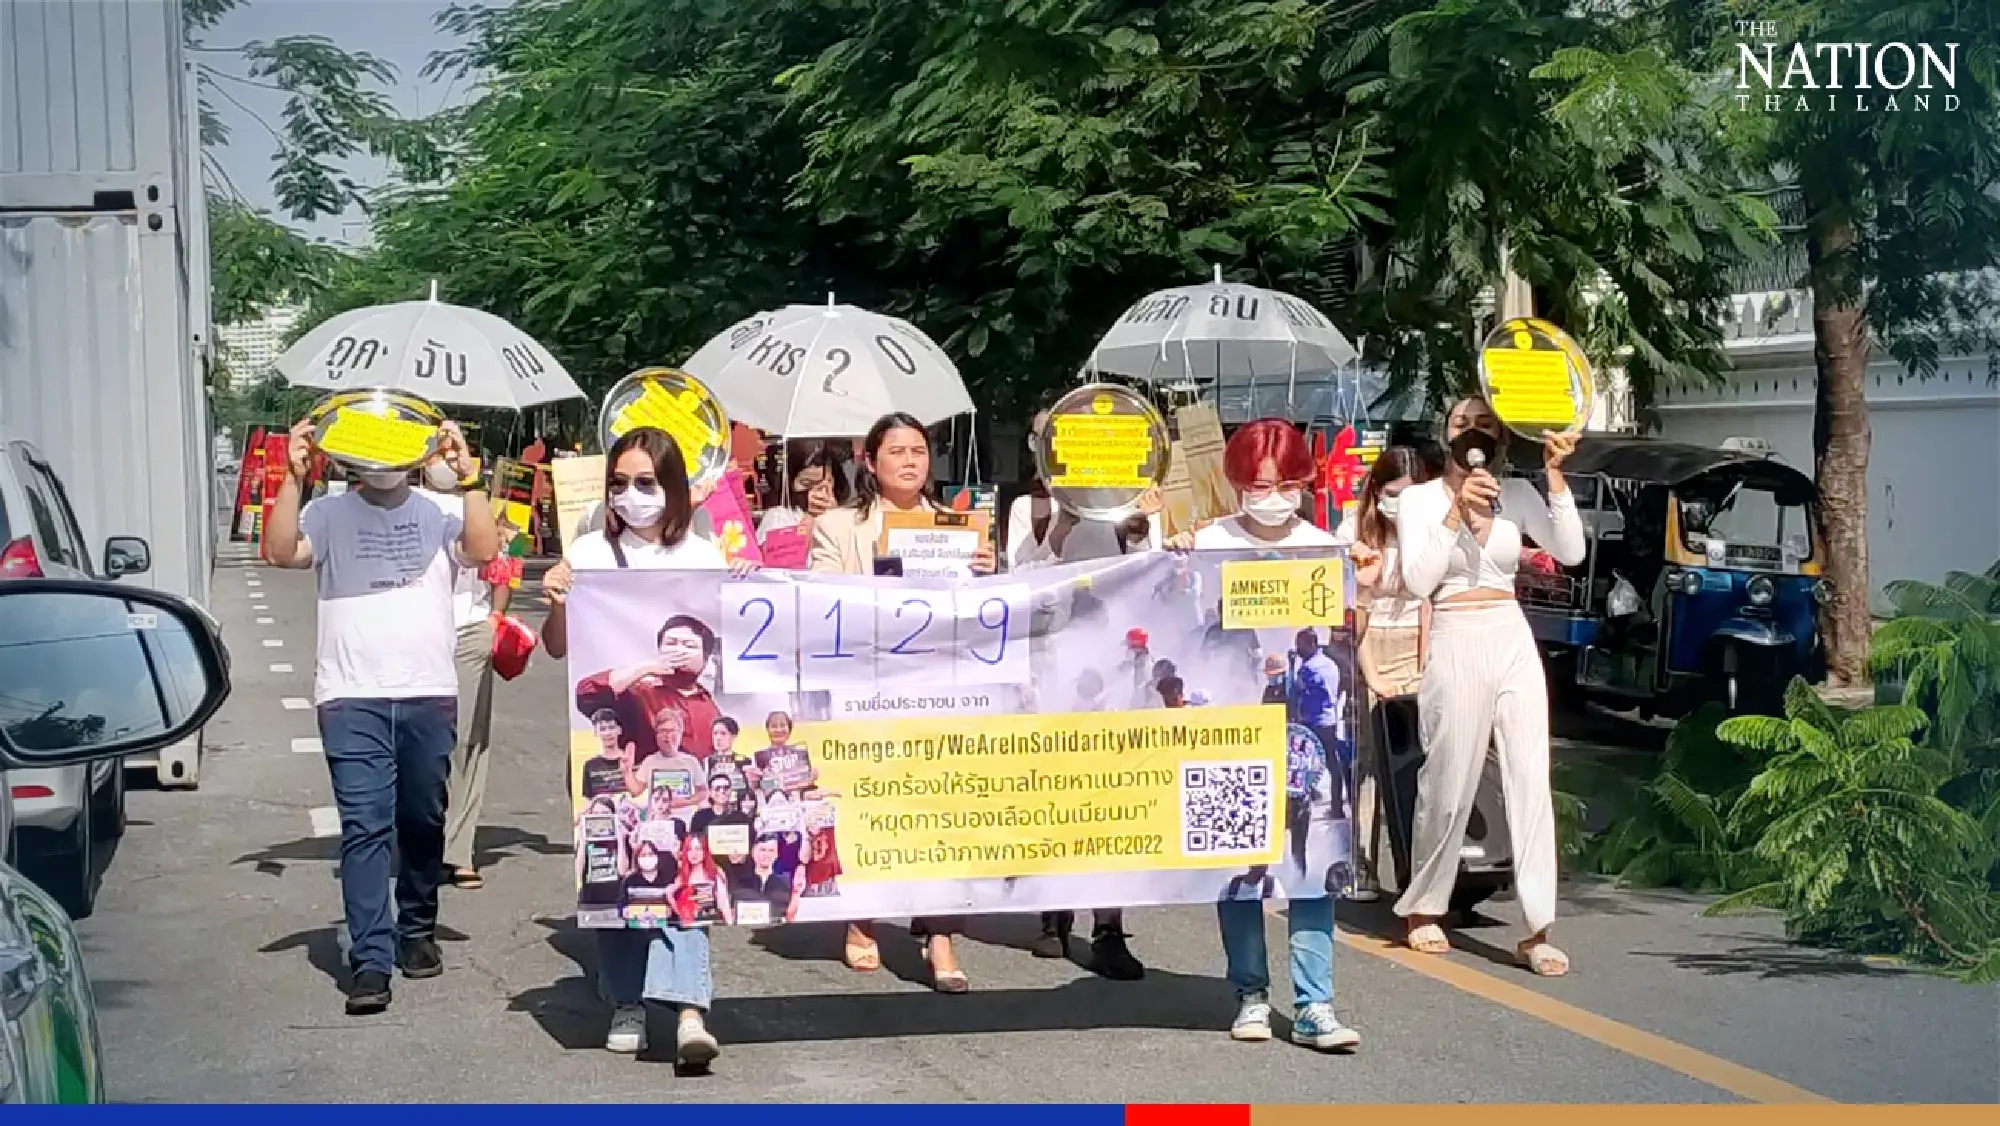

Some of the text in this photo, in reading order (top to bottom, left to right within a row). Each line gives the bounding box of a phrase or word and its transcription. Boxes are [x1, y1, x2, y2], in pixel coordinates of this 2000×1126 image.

[1230, 579, 1290, 595] AMNESTY
[844, 692, 990, 713] รายชื่อประชาชน จาก
[822, 725, 1263, 763] Change.org/WeAreInSolidarityWithMyanmar
[855, 834, 1164, 871] ในฐานะเจ้าภาพการจัด #APEC2022
